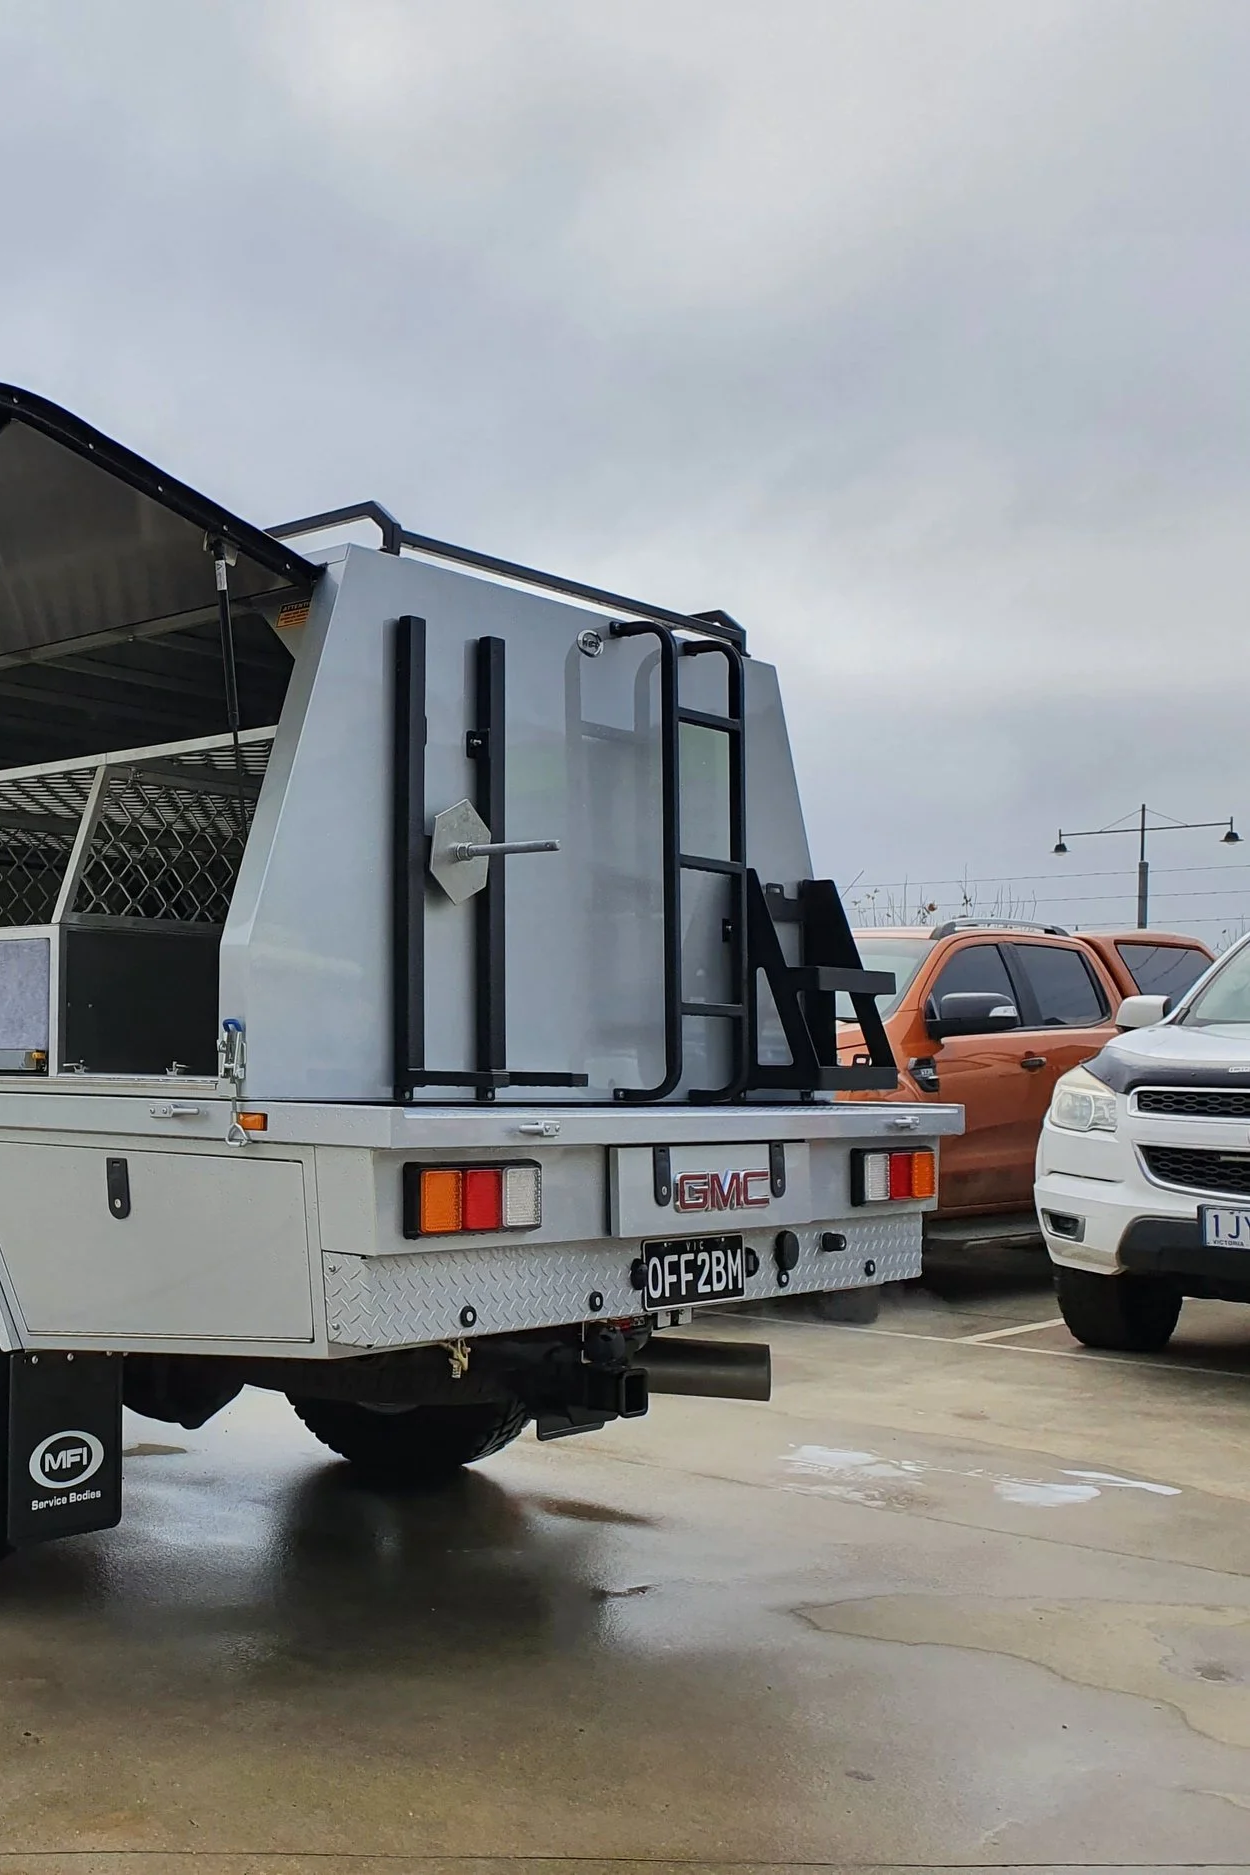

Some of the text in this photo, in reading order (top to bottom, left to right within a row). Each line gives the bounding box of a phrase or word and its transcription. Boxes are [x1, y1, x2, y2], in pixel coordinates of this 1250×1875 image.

[674, 1169, 770, 1213] GMC
[686, 1241, 704, 1251] VIC
[647, 1248, 743, 1299] OFF2BM
[44, 1446, 88, 1473] MFI
[31, 1489, 101, 1511] Service Bodies
